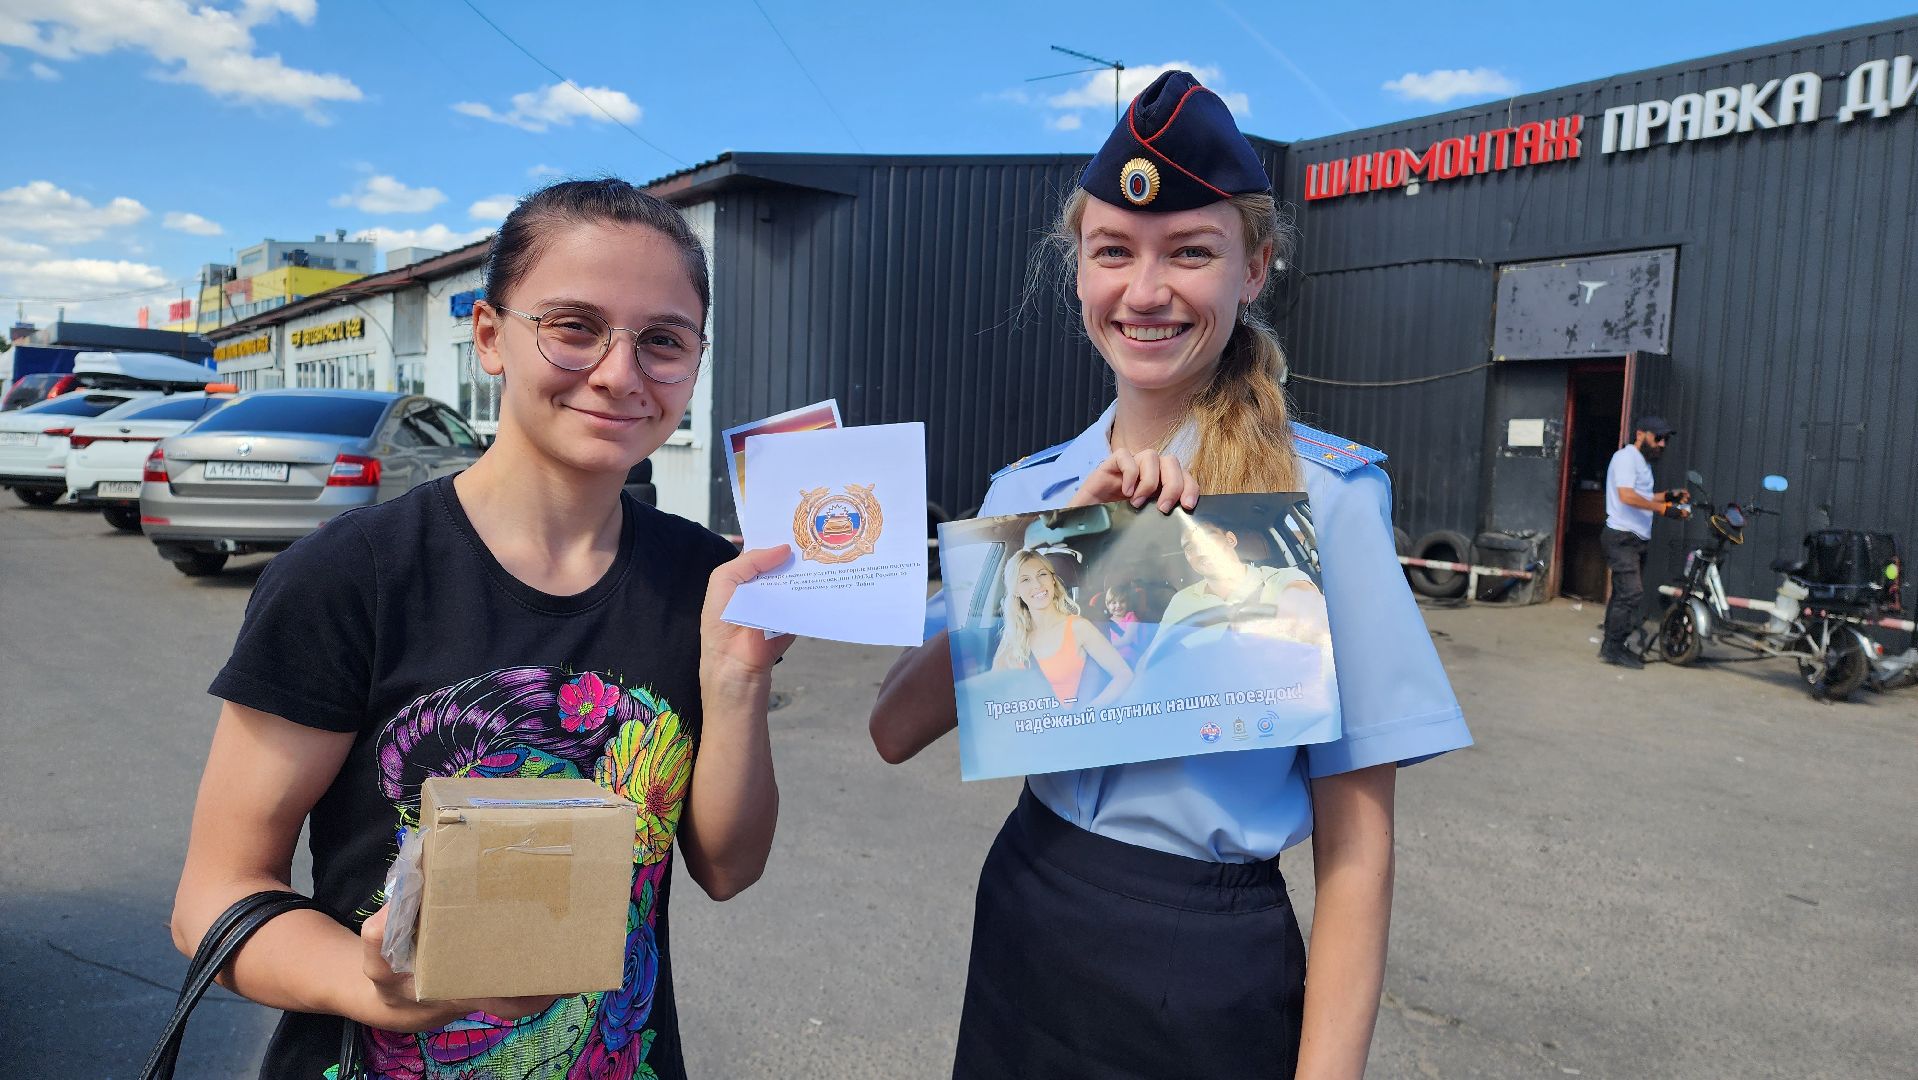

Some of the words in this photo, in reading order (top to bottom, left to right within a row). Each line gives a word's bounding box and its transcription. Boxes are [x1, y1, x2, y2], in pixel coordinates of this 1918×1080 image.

[1305, 115, 1584, 200] ШИНОМОНТАЖ
[1601, 71, 1823, 154] ПРАВКА
[985, 696, 1061, 719] Трезвость
[1015, 707, 1096, 734] надёжный
[1099, 701, 1163, 725] спутник
[1166, 692, 1222, 714] наших
[1224, 682, 1305, 706] поездок!
